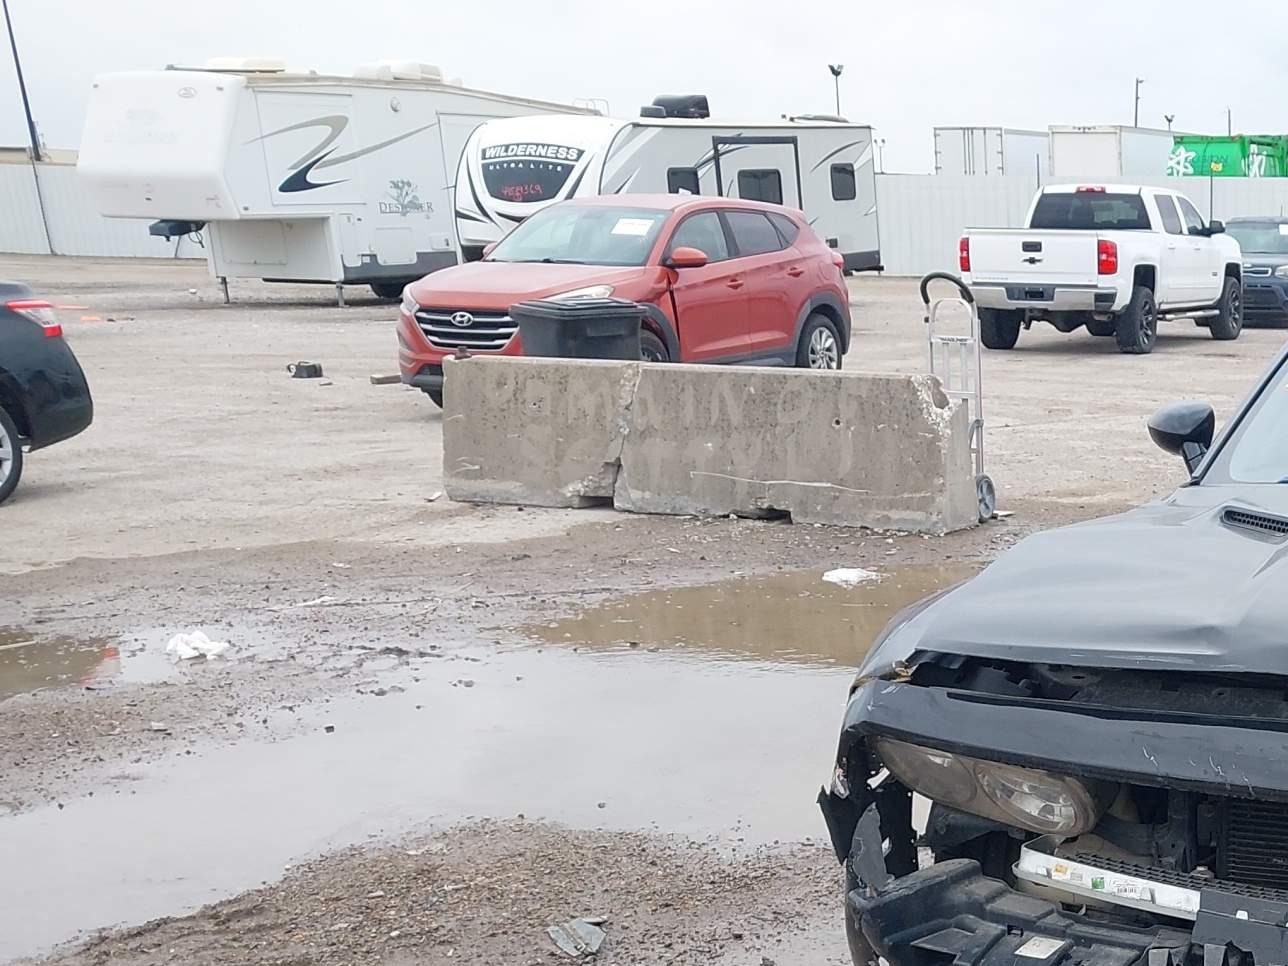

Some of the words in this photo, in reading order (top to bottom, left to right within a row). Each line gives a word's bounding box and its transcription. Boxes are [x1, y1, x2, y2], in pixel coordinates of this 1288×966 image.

[484, 144, 579, 160] WILDERNESS
[489, 162, 523, 170] ULTRA
[530, 162, 562, 172] LITE
[378, 202, 434, 213] DESER
